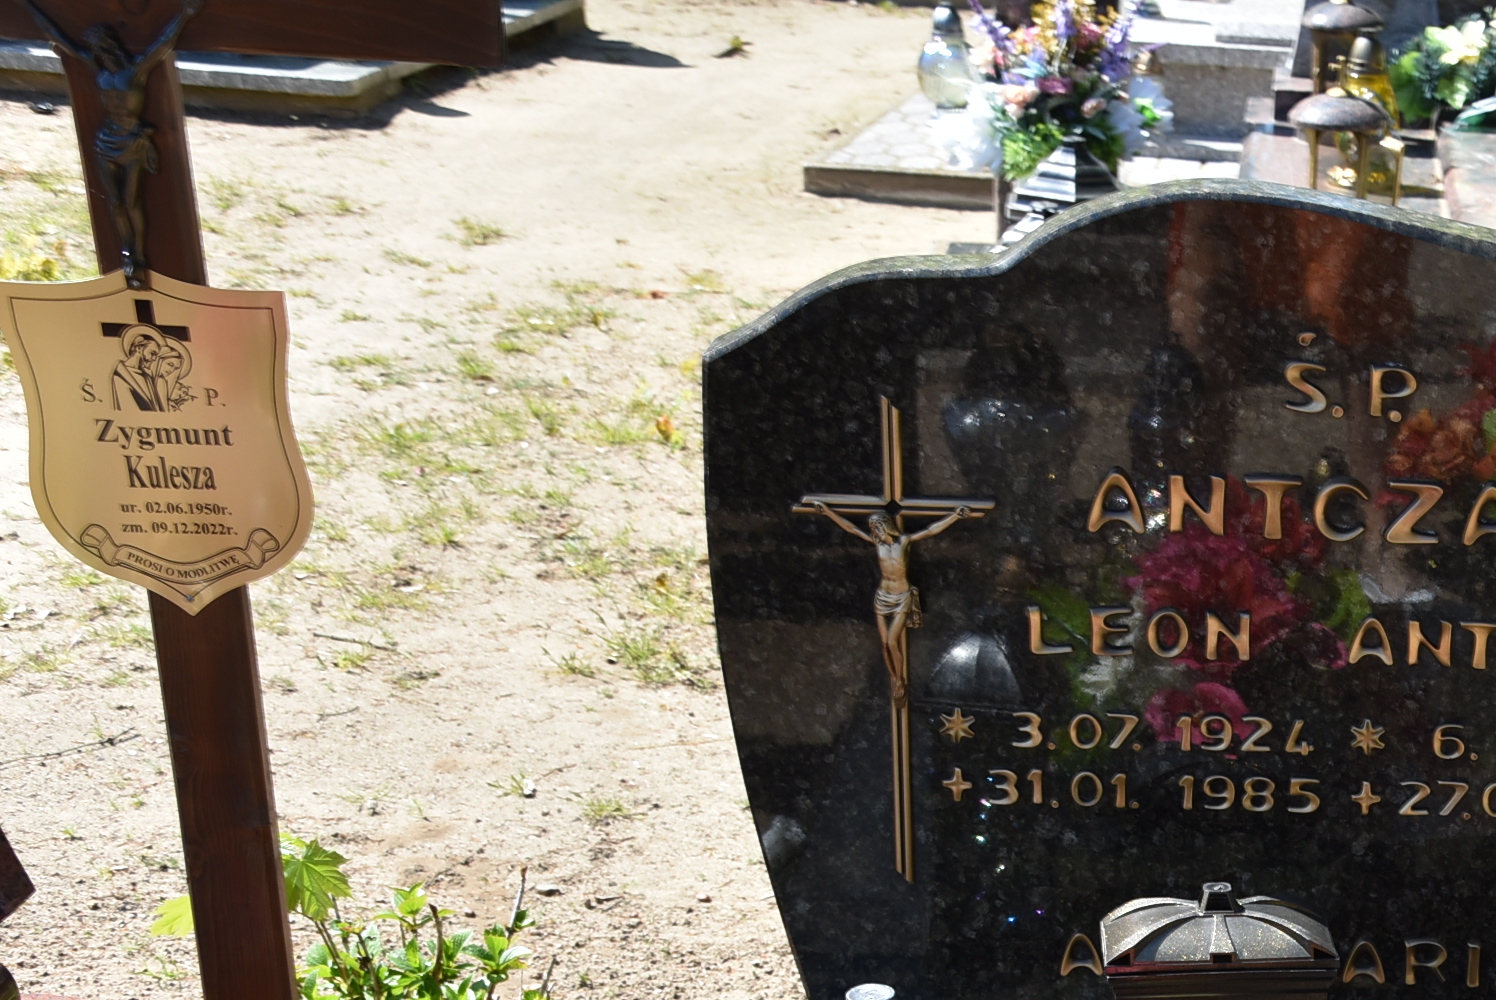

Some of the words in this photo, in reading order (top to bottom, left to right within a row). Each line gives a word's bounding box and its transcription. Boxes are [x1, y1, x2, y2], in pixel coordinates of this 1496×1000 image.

[94, 418, 234, 451] Zygmunt
[122, 454, 217, 490] Kulesza
[120, 502, 142, 514] ur.
[145, 501, 233, 516] 02.06.1950r.
[121, 522, 148, 534] zm.
[151, 521, 239, 536] 09.12.2022r.
[127, 551, 162, 573] PROSI
[165, 568, 175, 578] O
[177, 554, 241, 579] MODLITWĘ
[1027, 605, 1250, 661] LEON
